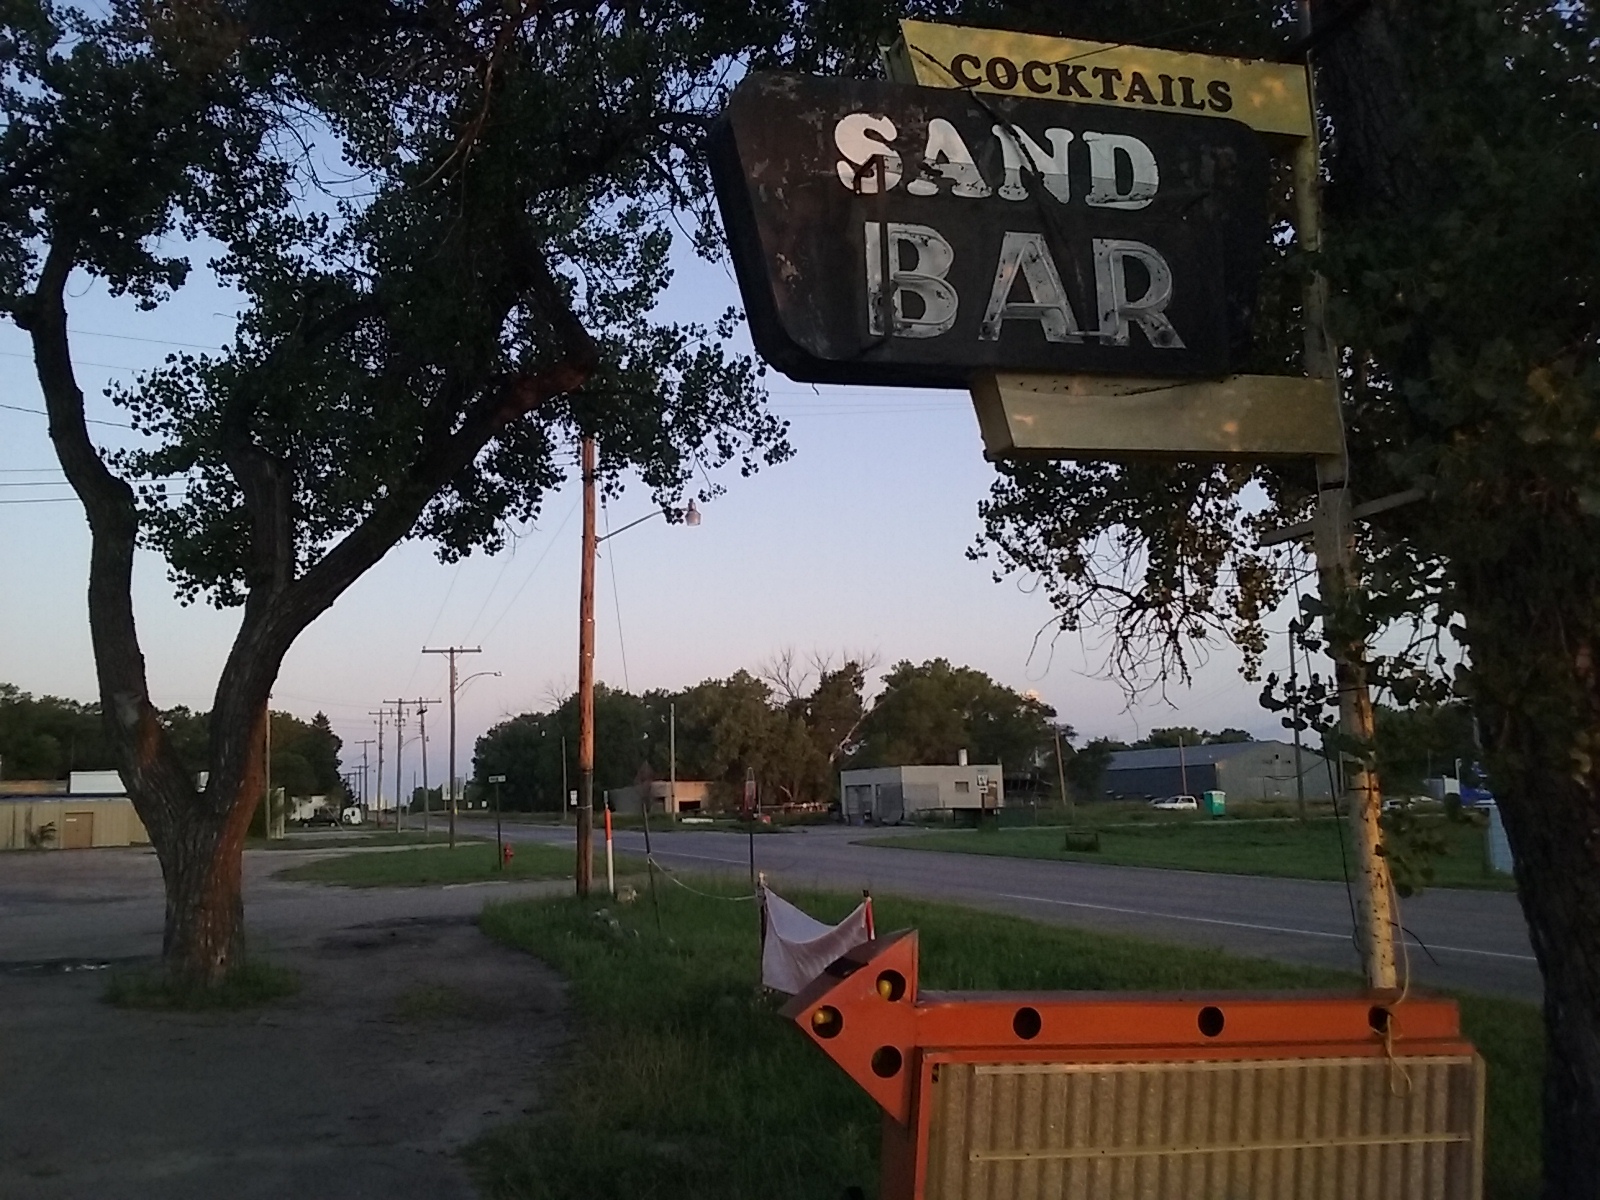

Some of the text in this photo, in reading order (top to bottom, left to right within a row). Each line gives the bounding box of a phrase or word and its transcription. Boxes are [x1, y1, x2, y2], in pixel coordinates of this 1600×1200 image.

[952, 53, 1232, 111] COCKTAILS
[834, 113, 1160, 210] SAND
[865, 221, 1186, 349] BAR
